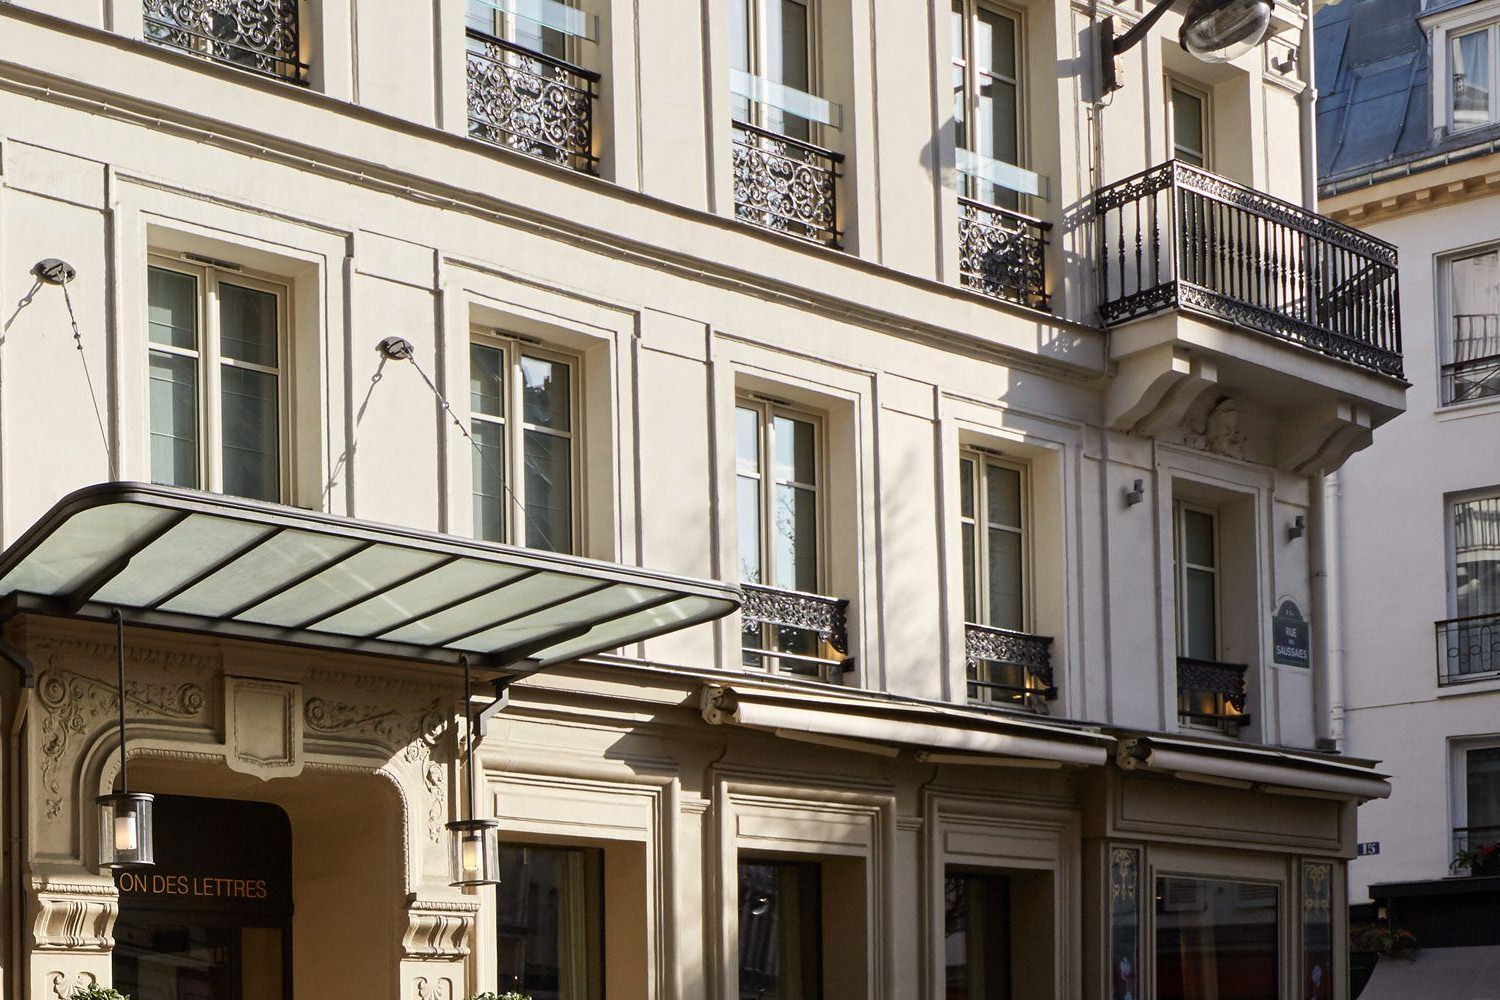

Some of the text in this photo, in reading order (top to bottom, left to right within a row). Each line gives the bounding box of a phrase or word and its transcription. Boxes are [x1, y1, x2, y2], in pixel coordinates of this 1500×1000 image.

[1363, 843, 1376, 855] 15
[152, 875, 189, 895] DES
[193, 877, 268, 898] LETTRES
